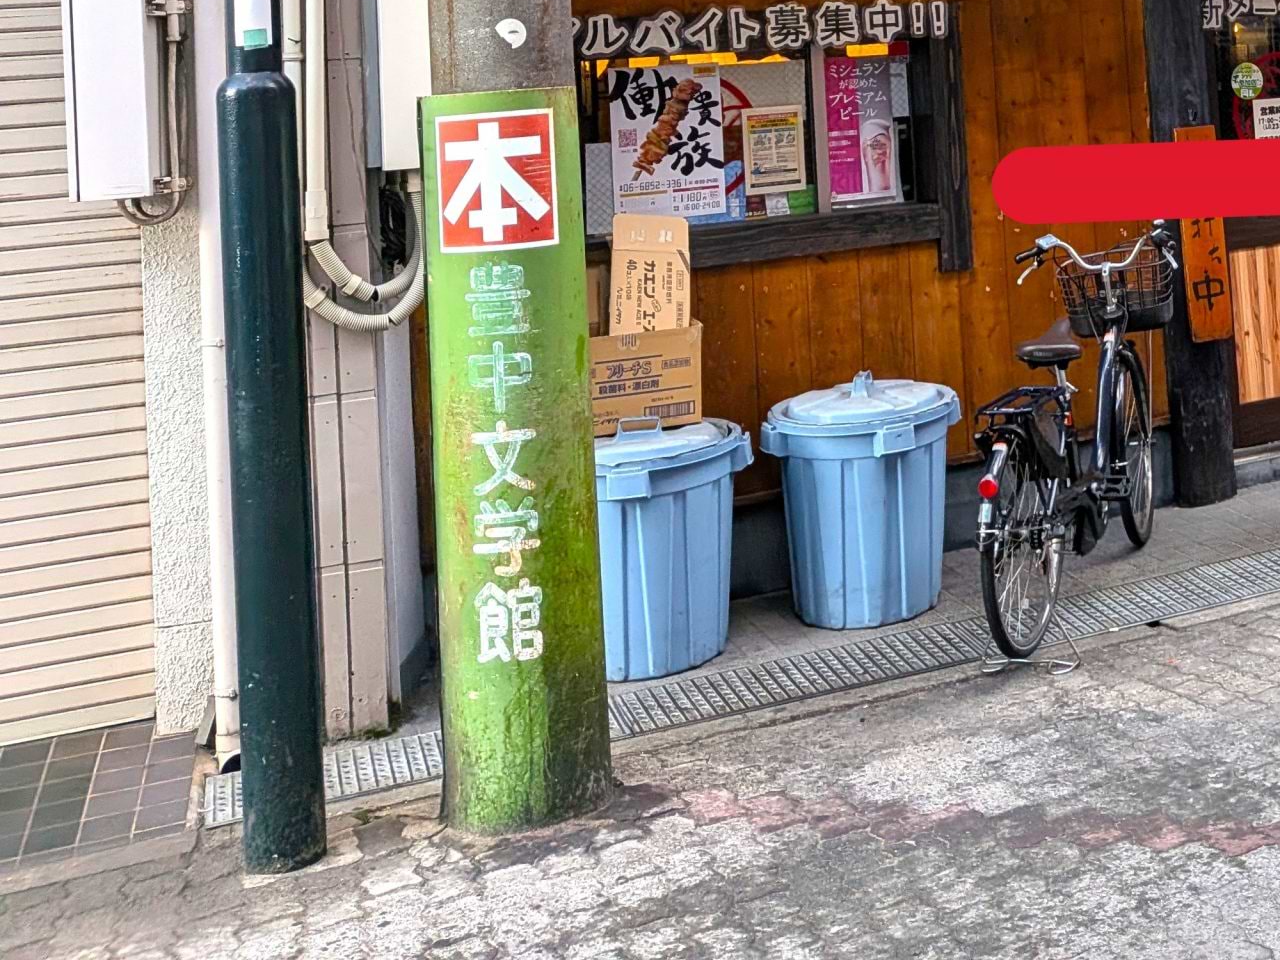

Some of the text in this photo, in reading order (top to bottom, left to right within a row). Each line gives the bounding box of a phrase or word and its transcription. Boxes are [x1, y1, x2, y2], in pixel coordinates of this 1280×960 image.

[572, 2, 943, 51] ルバイト募集中!!
[829, 62, 885, 78] ミシュラン
[839, 78, 877, 90] が認めた
[829, 91, 887, 107] プレミアム
[840, 107, 877, 121] ビール
[443, 122, 551, 242] 本
[464, 261, 544, 663] 豊中文学館
